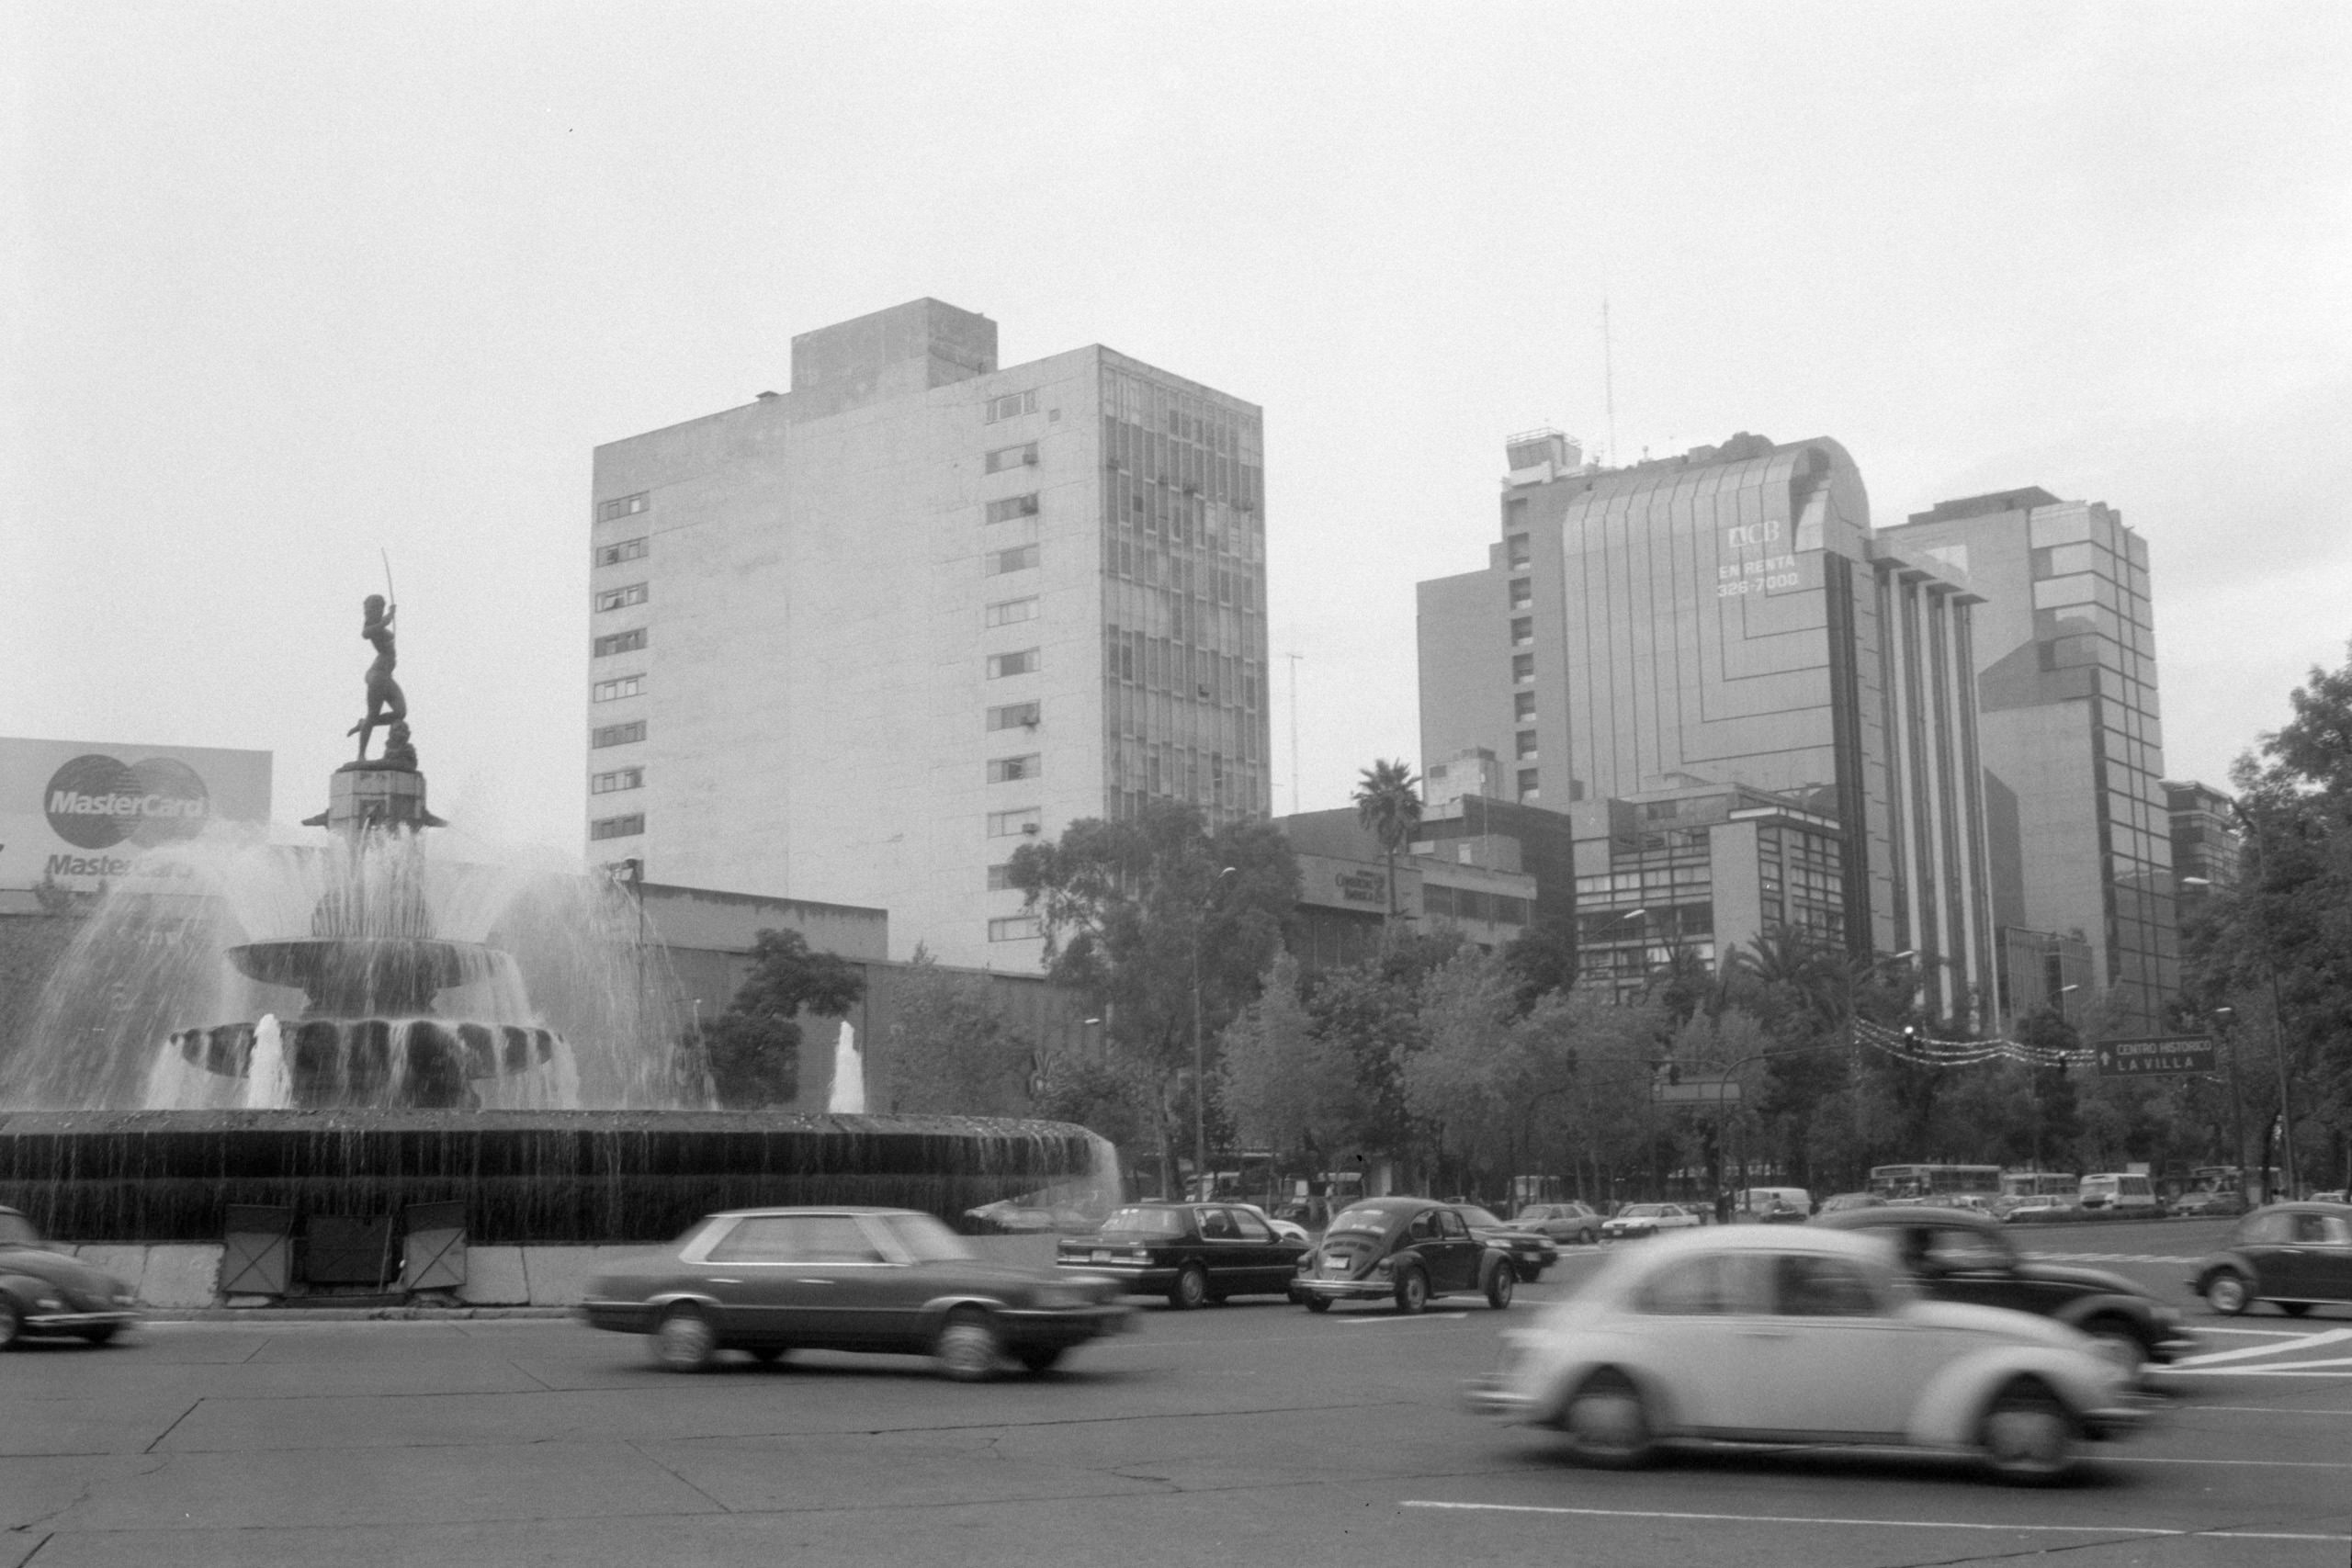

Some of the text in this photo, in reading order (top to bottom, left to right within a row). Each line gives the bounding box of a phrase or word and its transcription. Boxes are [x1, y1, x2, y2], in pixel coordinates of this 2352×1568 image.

[1719, 555, 1795, 579] EN RENTA
[49, 791, 206, 817] MasterCard
[2117, 1041, 2211, 1055] CENTRO HISTORICO
[2117, 1056, 2193, 1071] LA VILLA
